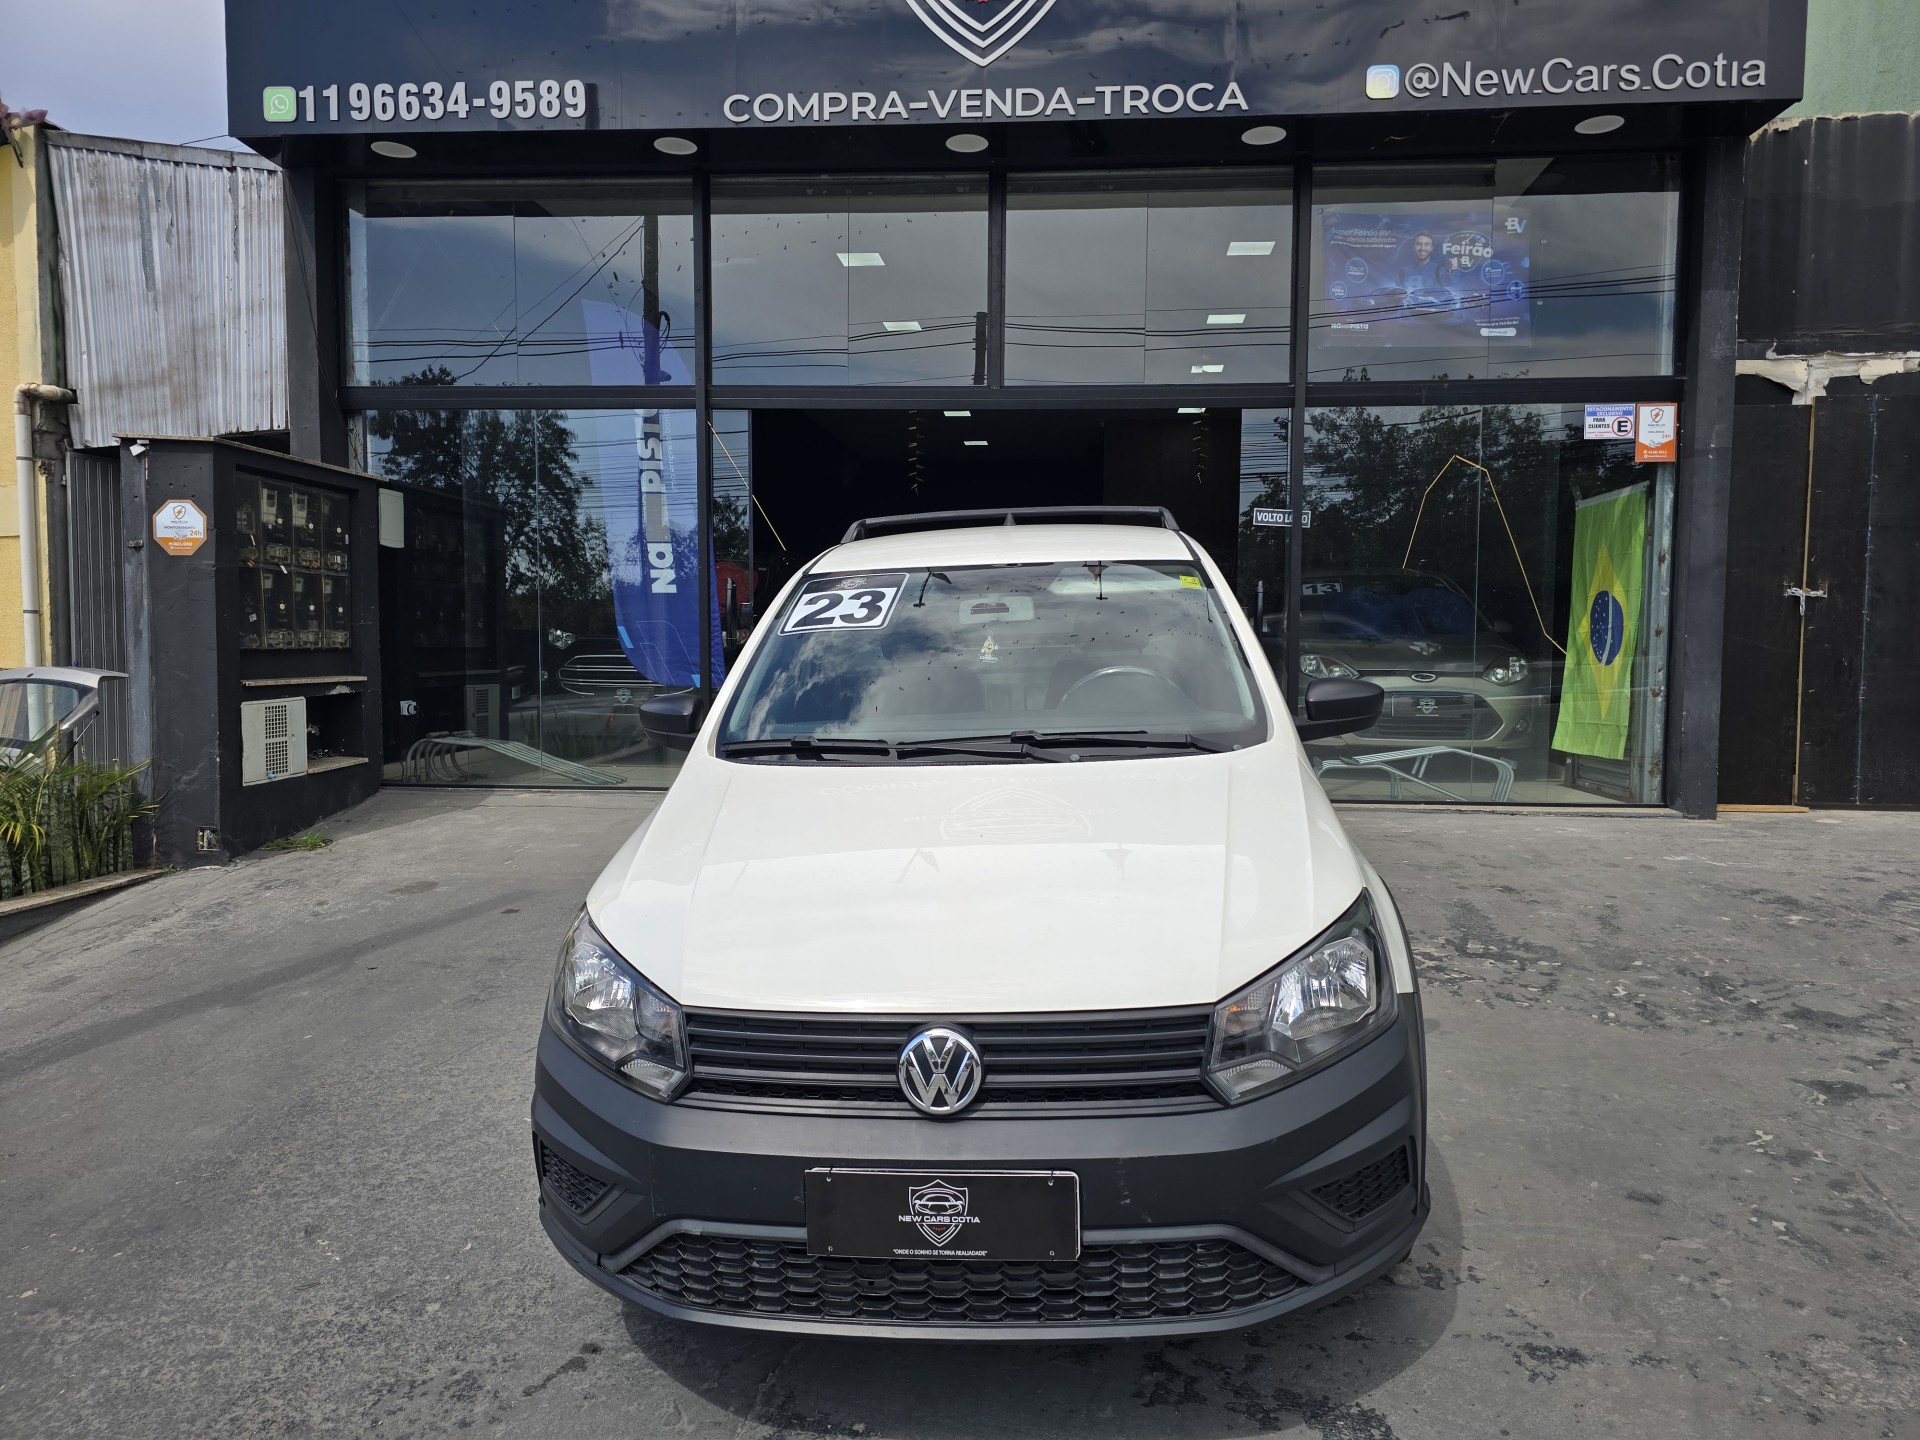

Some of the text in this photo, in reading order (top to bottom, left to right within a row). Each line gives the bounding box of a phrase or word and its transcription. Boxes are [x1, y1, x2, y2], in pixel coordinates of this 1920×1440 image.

[350, 79, 587, 121] 96634-9589
[1442, 241, 1494, 258] Feirão
[1617, 420, 1629, 433] E
[1256, 512, 1283, 523] VOLTO
[189, 529, 202, 537] 24h
[791, 590, 887, 629] 23
[898, 1214, 922, 1222] NEW
[923, 1215, 950, 1223] CARS
